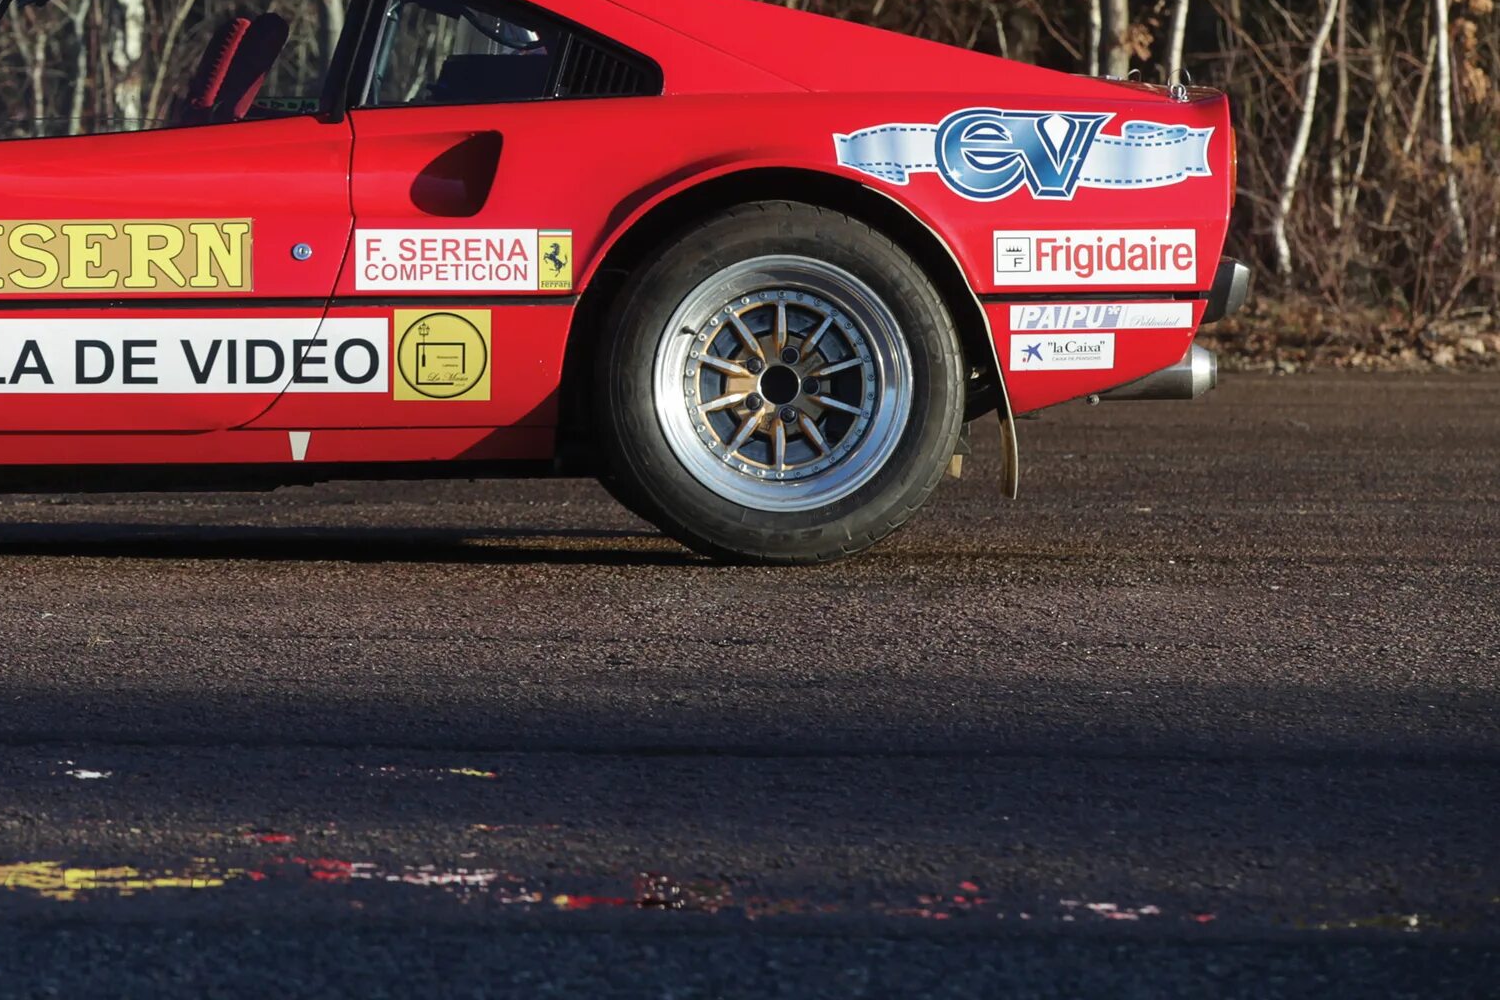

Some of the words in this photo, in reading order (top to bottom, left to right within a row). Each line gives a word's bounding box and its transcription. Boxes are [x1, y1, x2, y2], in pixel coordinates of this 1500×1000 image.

[365, 238, 387, 262] F.
[398, 238, 529, 262] SERENA
[1035, 236, 1193, 279] Frigidaire
[364, 263, 528, 281] COMPETICION
[540, 280, 572, 289] Ferrari
[75, 339, 159, 385] DE
[181, 338, 380, 385] VIDEO
